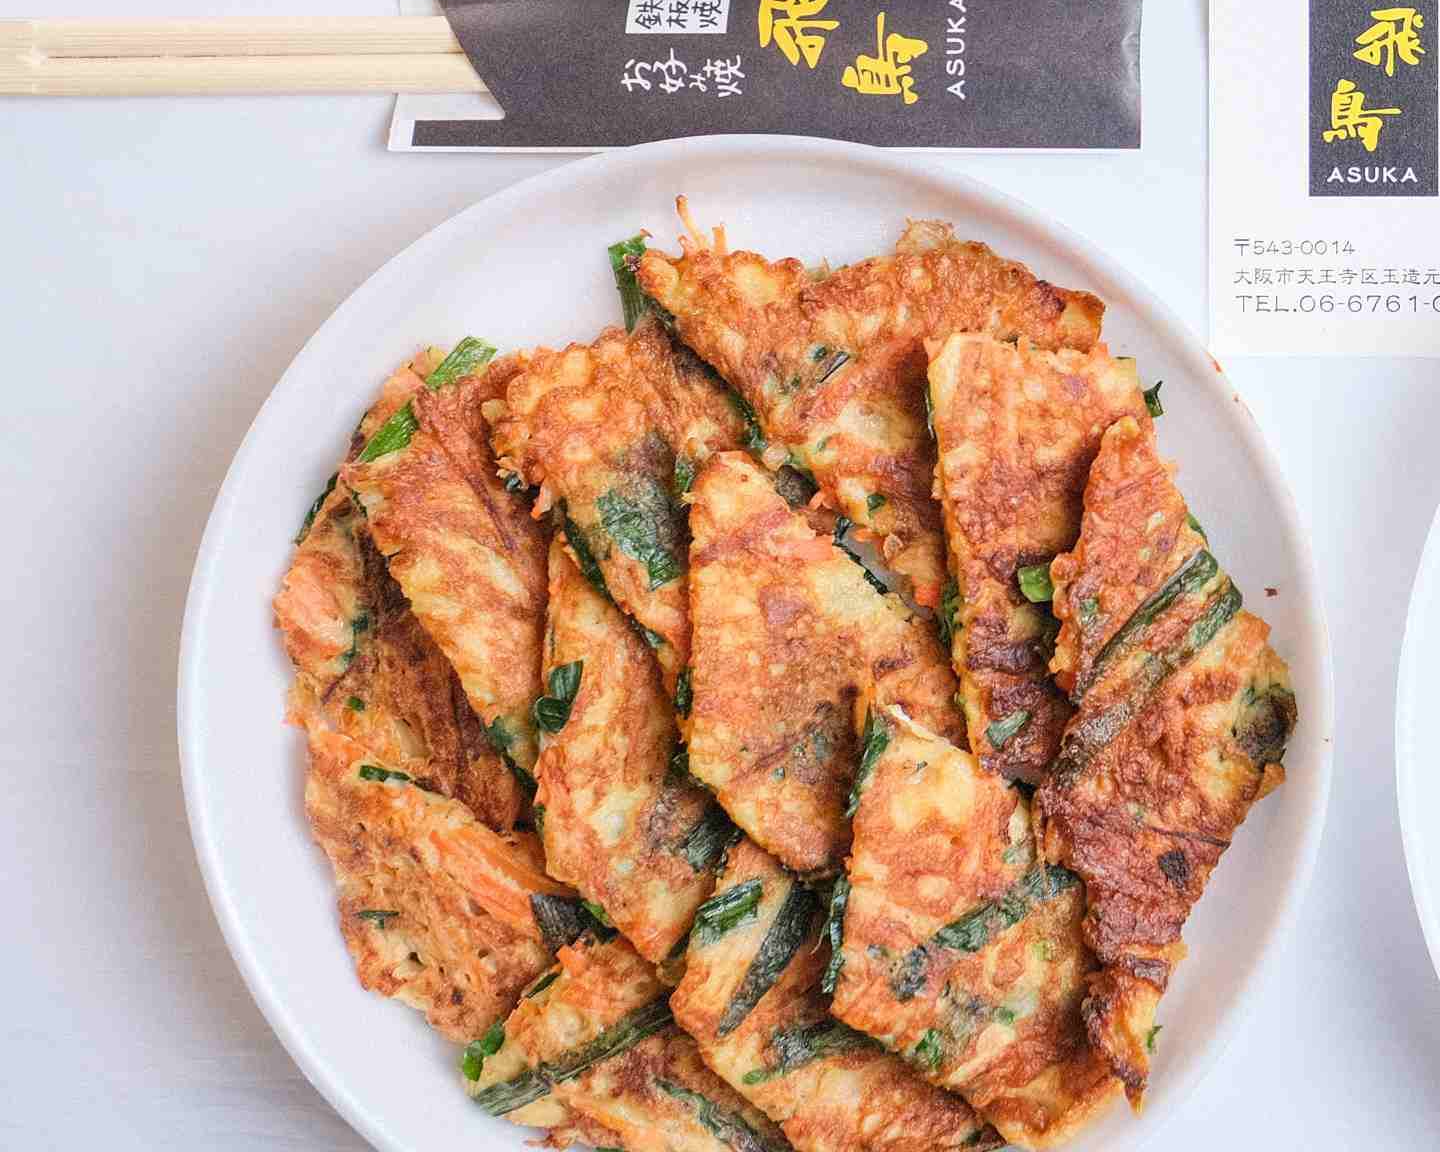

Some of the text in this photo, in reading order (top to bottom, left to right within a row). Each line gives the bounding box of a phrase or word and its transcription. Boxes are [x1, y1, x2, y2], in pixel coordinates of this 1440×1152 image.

[619, 48, 745, 98] お好み焼
[1322, 7, 1426, 152] 飛鳥
[1326, 166, 1419, 184] ASUKA
